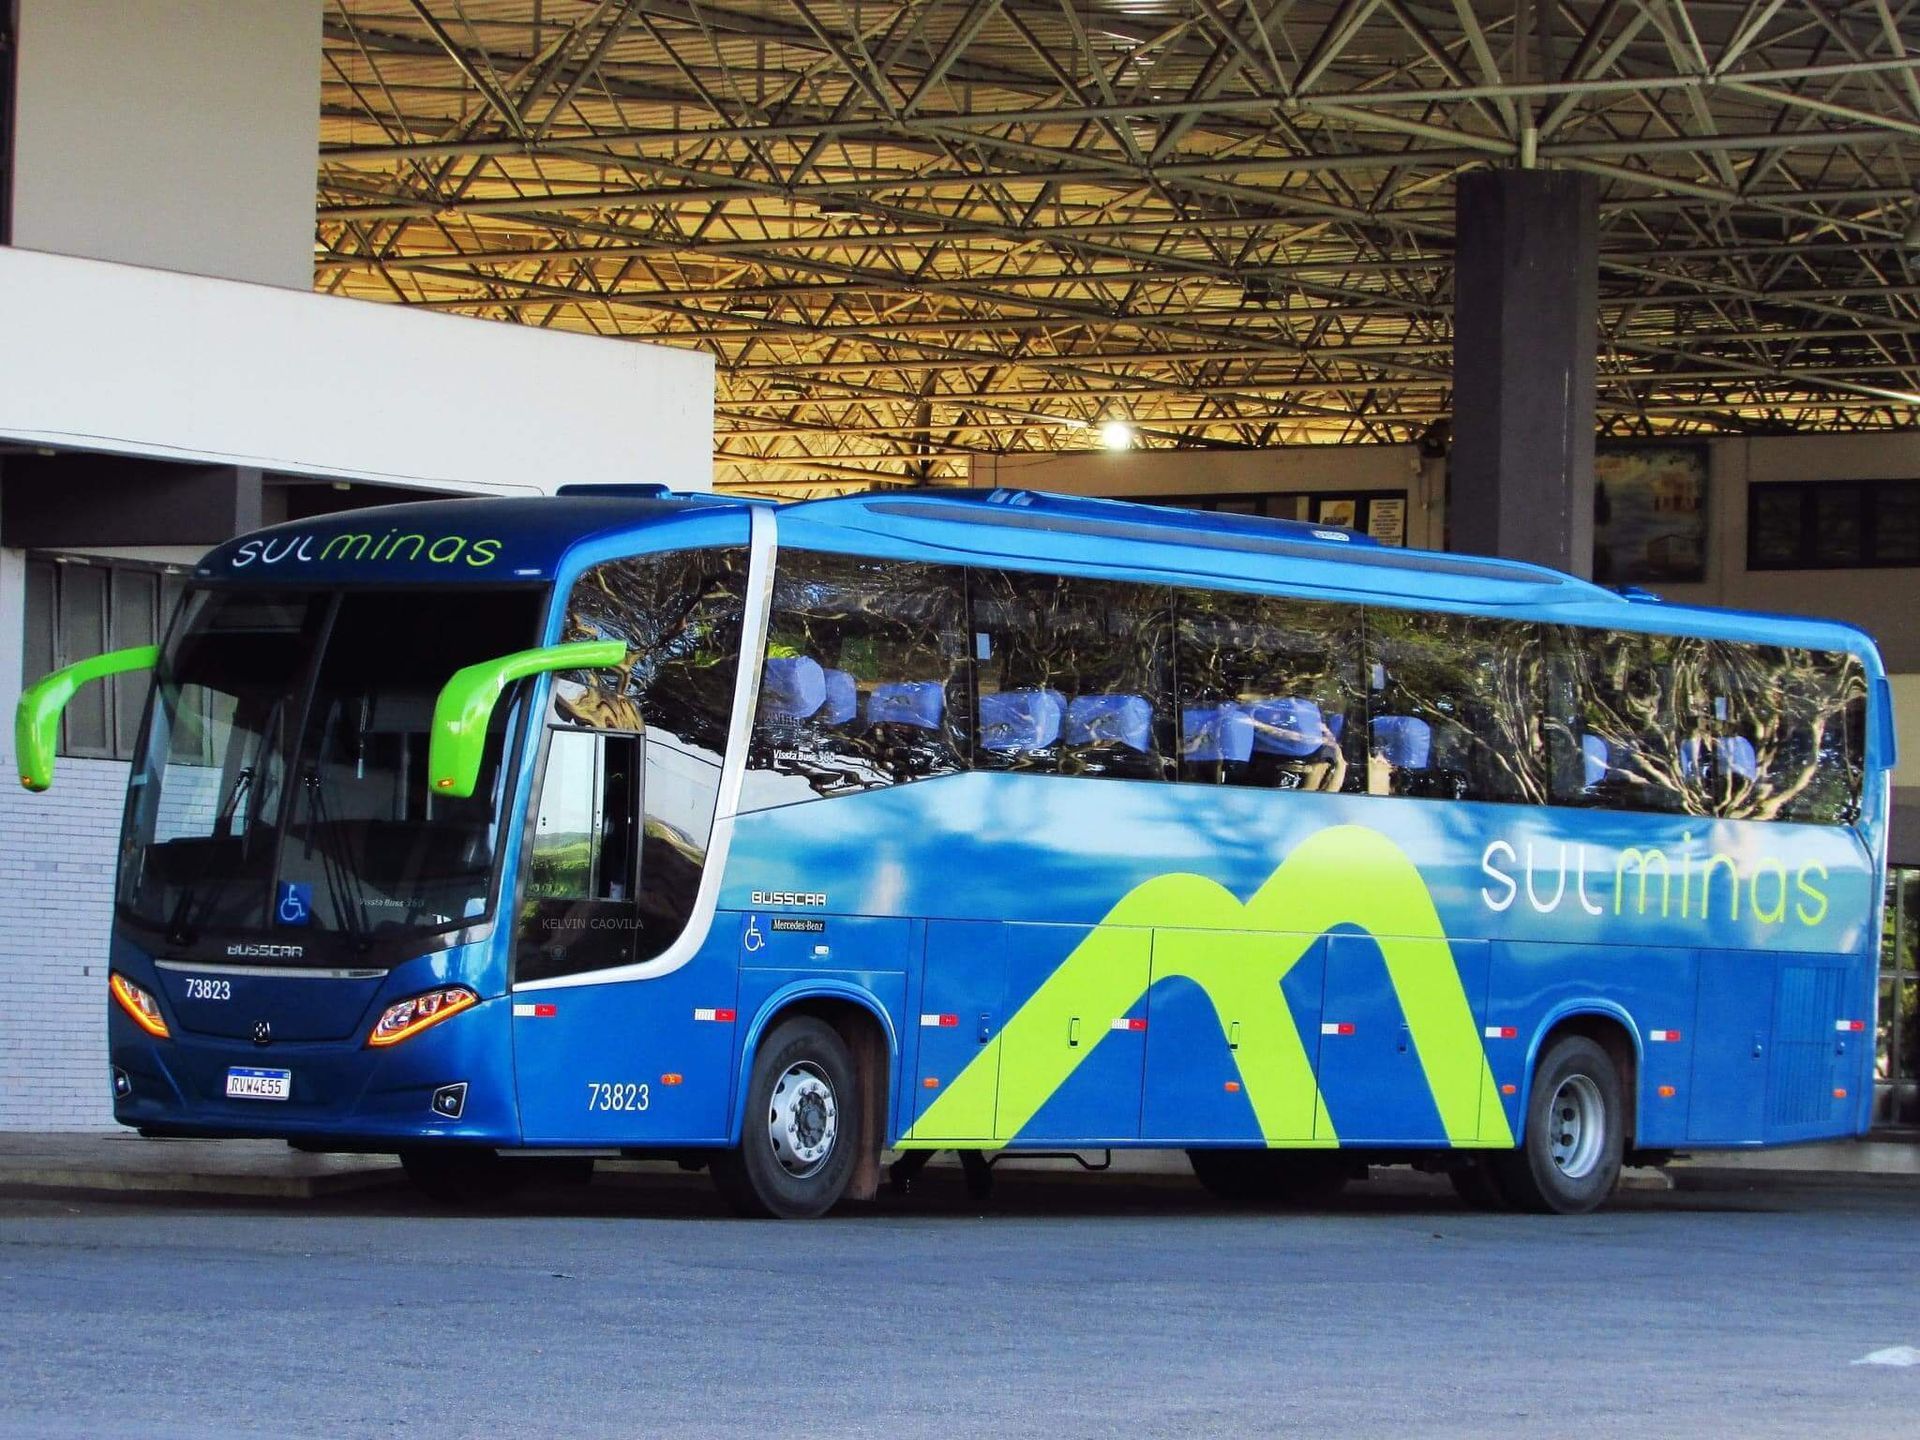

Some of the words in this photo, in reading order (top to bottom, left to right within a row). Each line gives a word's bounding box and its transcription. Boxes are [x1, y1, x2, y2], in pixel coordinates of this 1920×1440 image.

[751, 891, 827, 907] BUSSCAR
[772, 919, 824, 931] Mercedes-Benz
[227, 944, 303, 958] BUSSCAR
[186, 978, 231, 1000] 73823
[231, 1077, 282, 1095] RVW4E55
[588, 1083, 649, 1111] 73823
